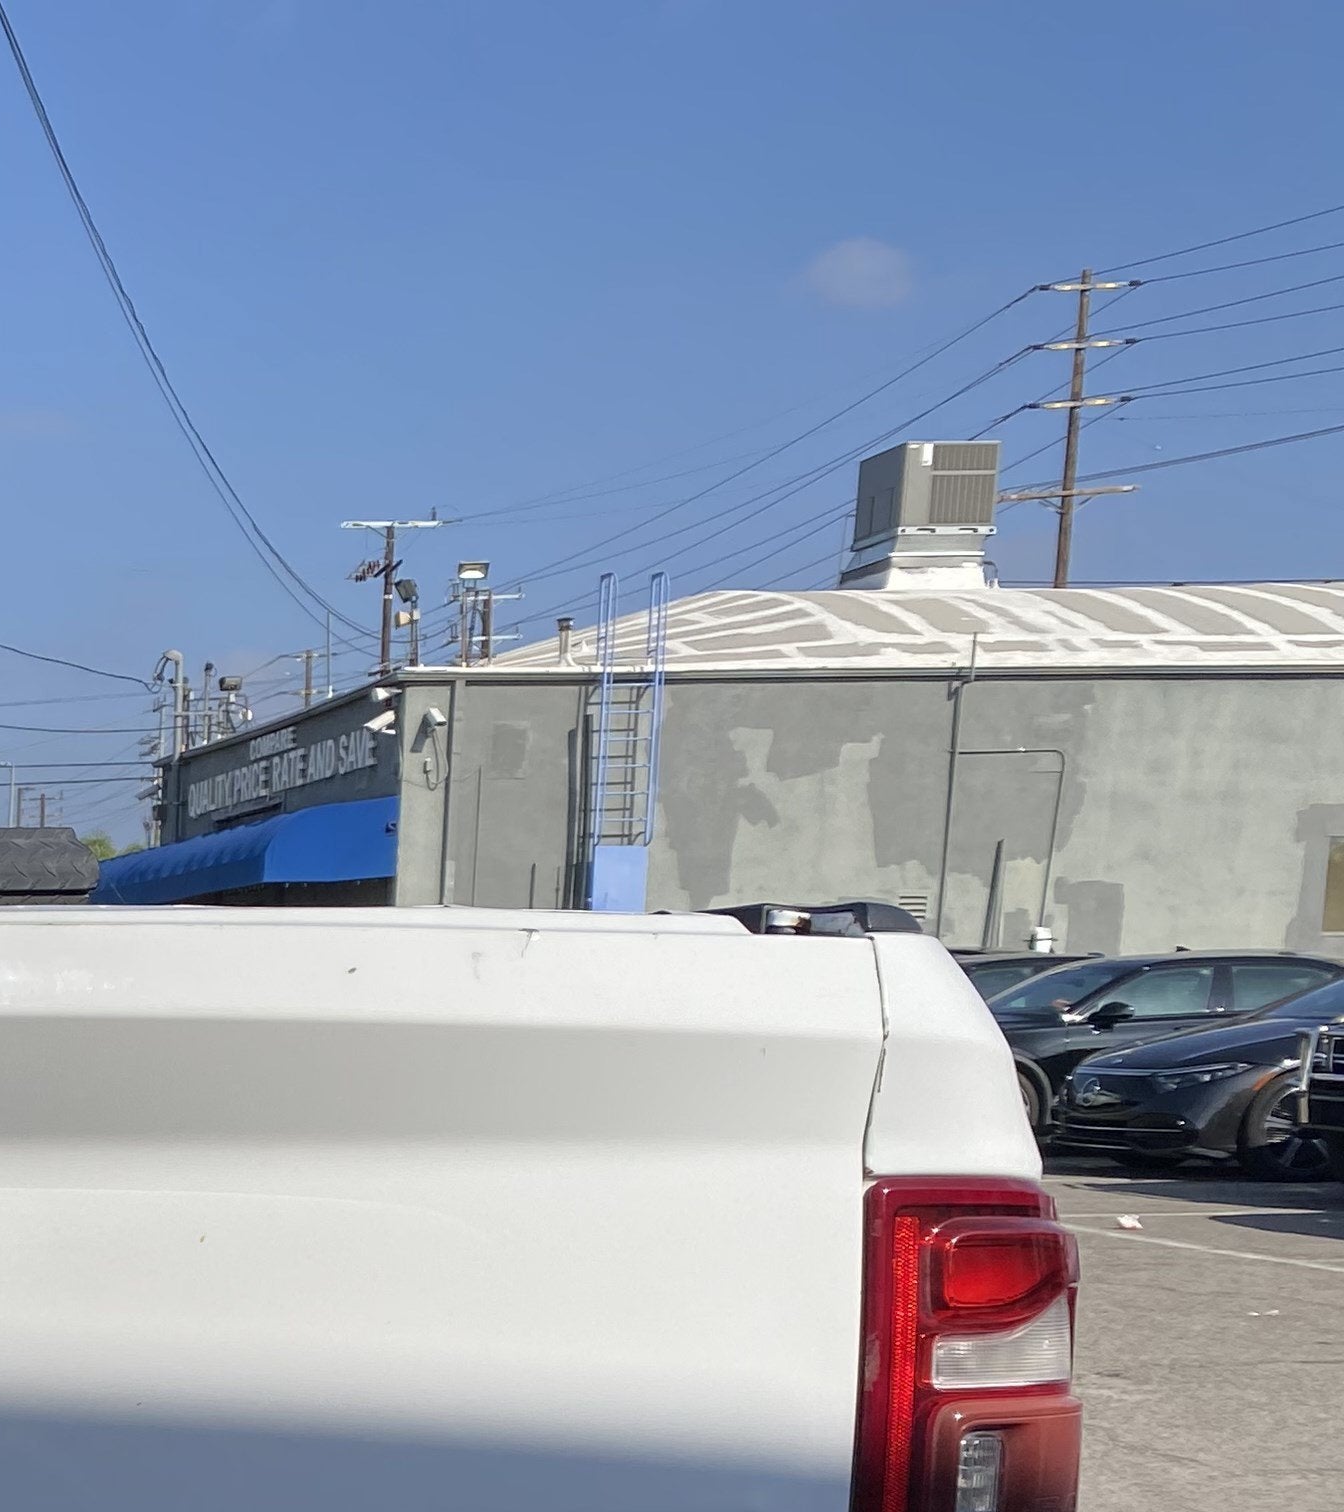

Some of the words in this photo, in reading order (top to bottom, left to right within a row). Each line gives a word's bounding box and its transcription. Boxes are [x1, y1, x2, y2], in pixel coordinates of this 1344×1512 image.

[234, 760, 270, 801] PRICE,
[272, 748, 307, 792] RATE
[307, 739, 335, 782] AND
[339, 727, 378, 775] SAVE
[250, 726, 297, 760] COMPARE
